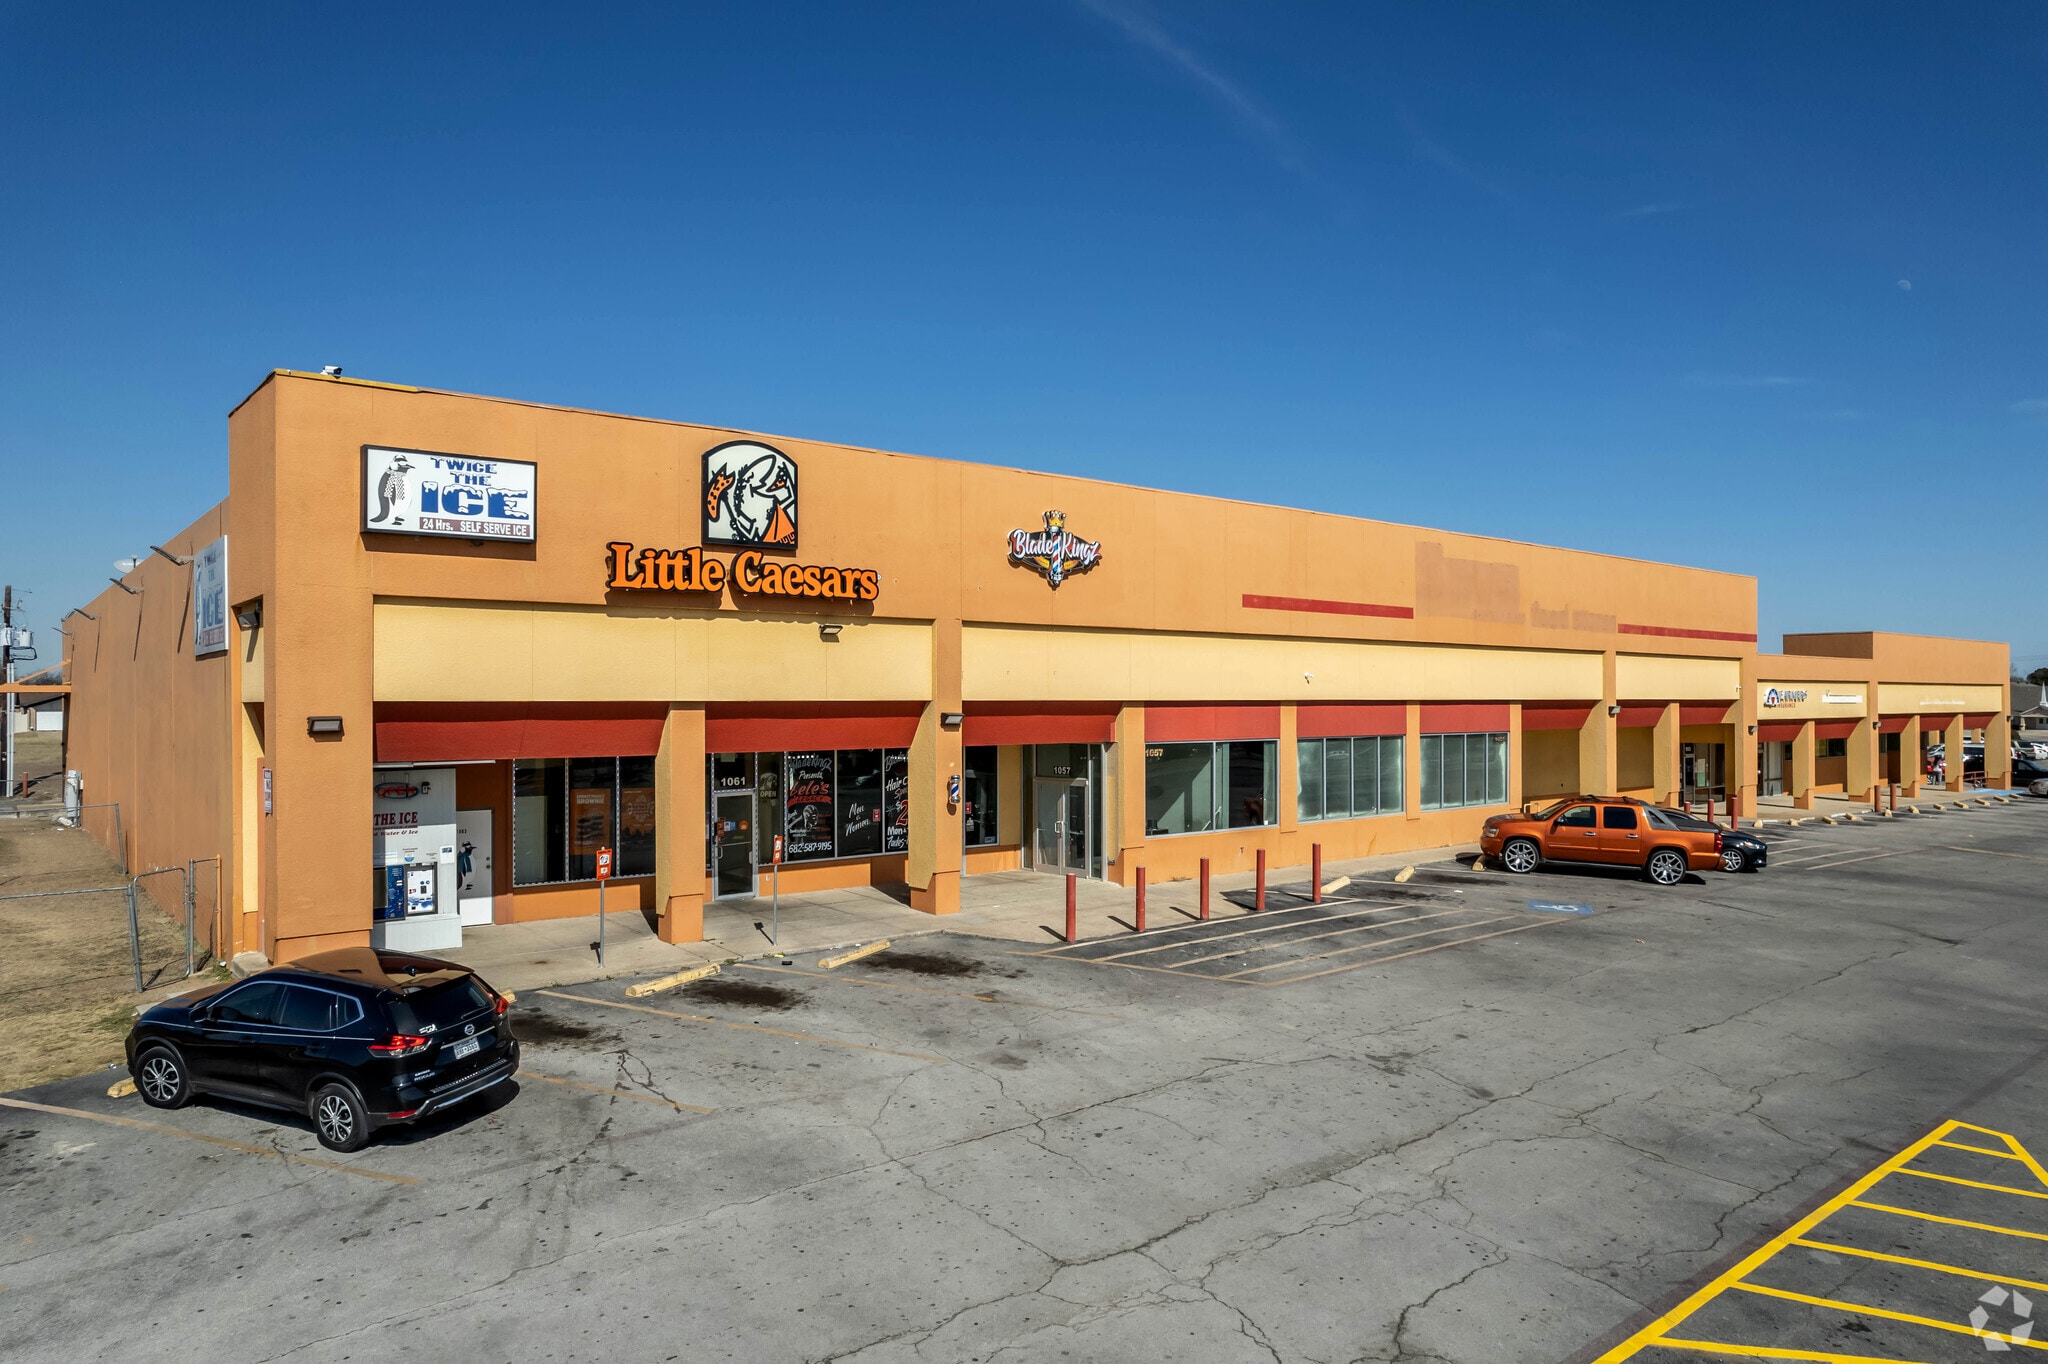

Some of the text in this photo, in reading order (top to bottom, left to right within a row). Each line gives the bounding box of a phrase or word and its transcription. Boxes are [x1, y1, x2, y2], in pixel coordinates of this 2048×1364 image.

[430, 457, 497, 474] TWICE
[450, 472, 491, 486] THE
[421, 481, 529, 520] ICE
[422, 518, 454, 531] 24 Hrs.
[460, 521, 527, 536] SELF SERVE ICE
[1011, 529, 1101, 565] Blade Kingz
[608, 542, 879, 600] Little Caesars
[202, 584, 223, 629] ICE
[1053, 766, 1071, 775] 1057
[720, 776, 746, 787] 1061
[885, 777, 902, 792] Hair
[377, 785, 415, 798] OPEN
[759, 790, 777, 798] OPEN
[373, 811, 418, 826] THE ICE
[788, 840, 833, 854] 682-587-9195
